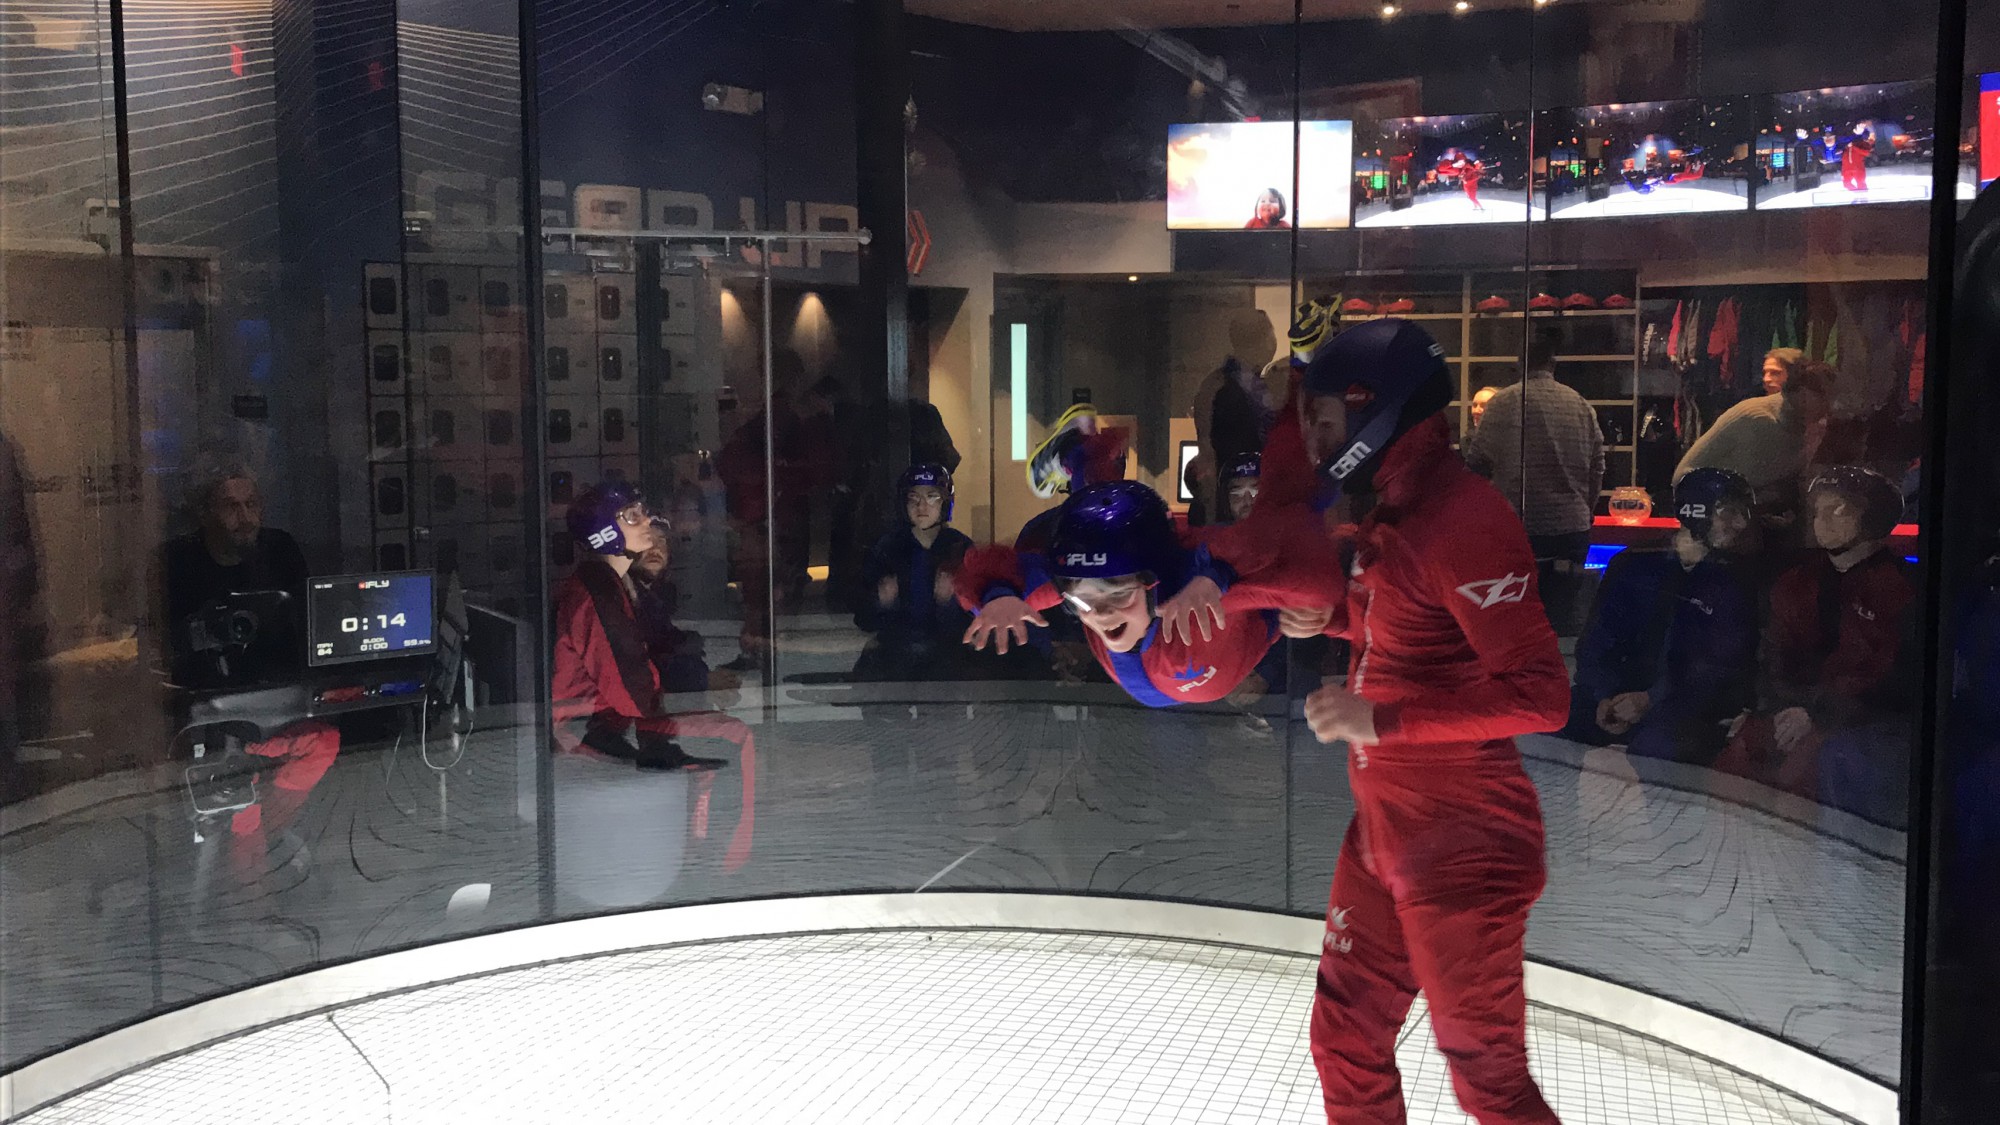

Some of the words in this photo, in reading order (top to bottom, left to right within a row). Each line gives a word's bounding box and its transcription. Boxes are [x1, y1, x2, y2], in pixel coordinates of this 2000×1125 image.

[1680, 503, 1706, 518] 42
[588, 525, 618, 549] 36
[1066, 552, 1107, 567] iFLY
[365, 579, 390, 589] iFLY
[360, 642, 388, 650] 0:00
